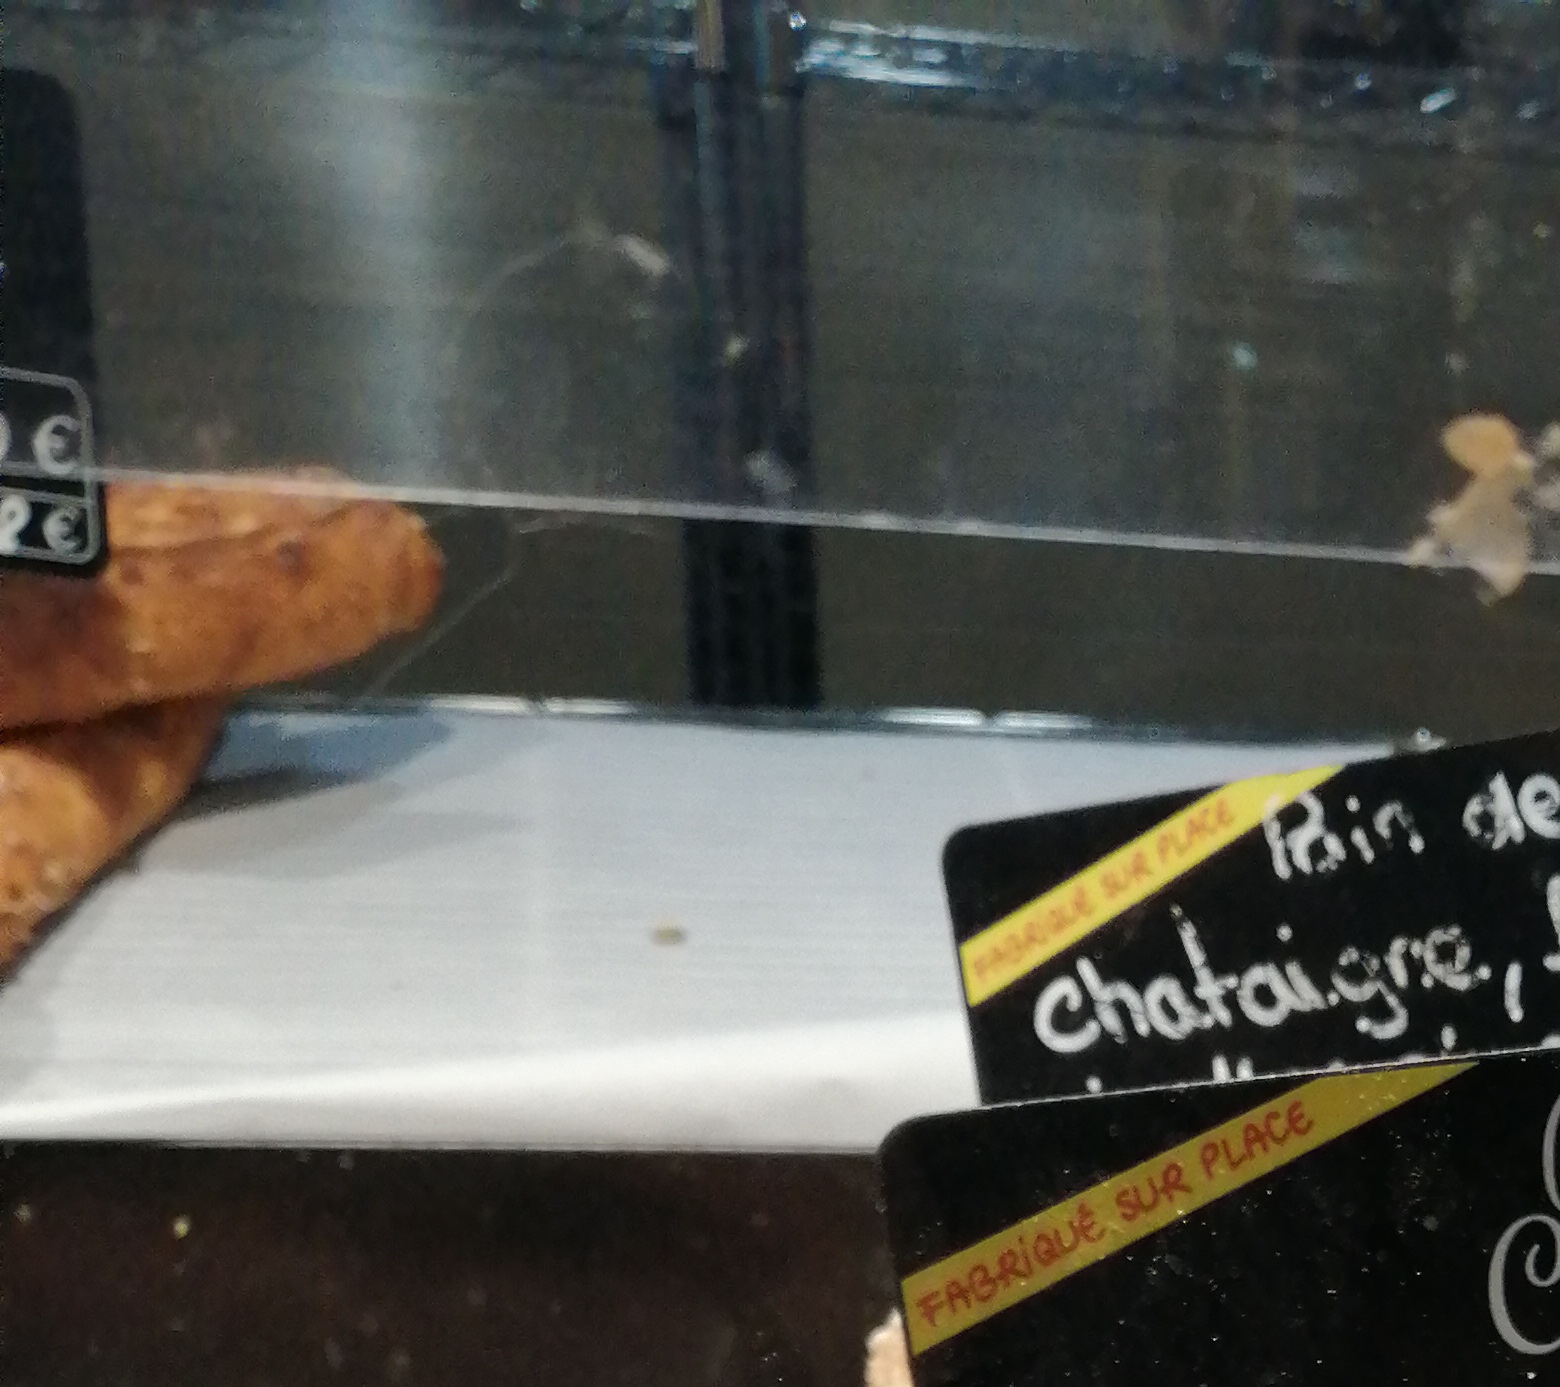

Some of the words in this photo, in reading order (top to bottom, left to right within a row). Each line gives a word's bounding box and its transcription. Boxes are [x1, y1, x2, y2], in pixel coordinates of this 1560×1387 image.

[1262, 790, 1425, 881] Pain
[1114, 1161, 1192, 1224] SUR
[1200, 1098, 1314, 1180] PLACE
